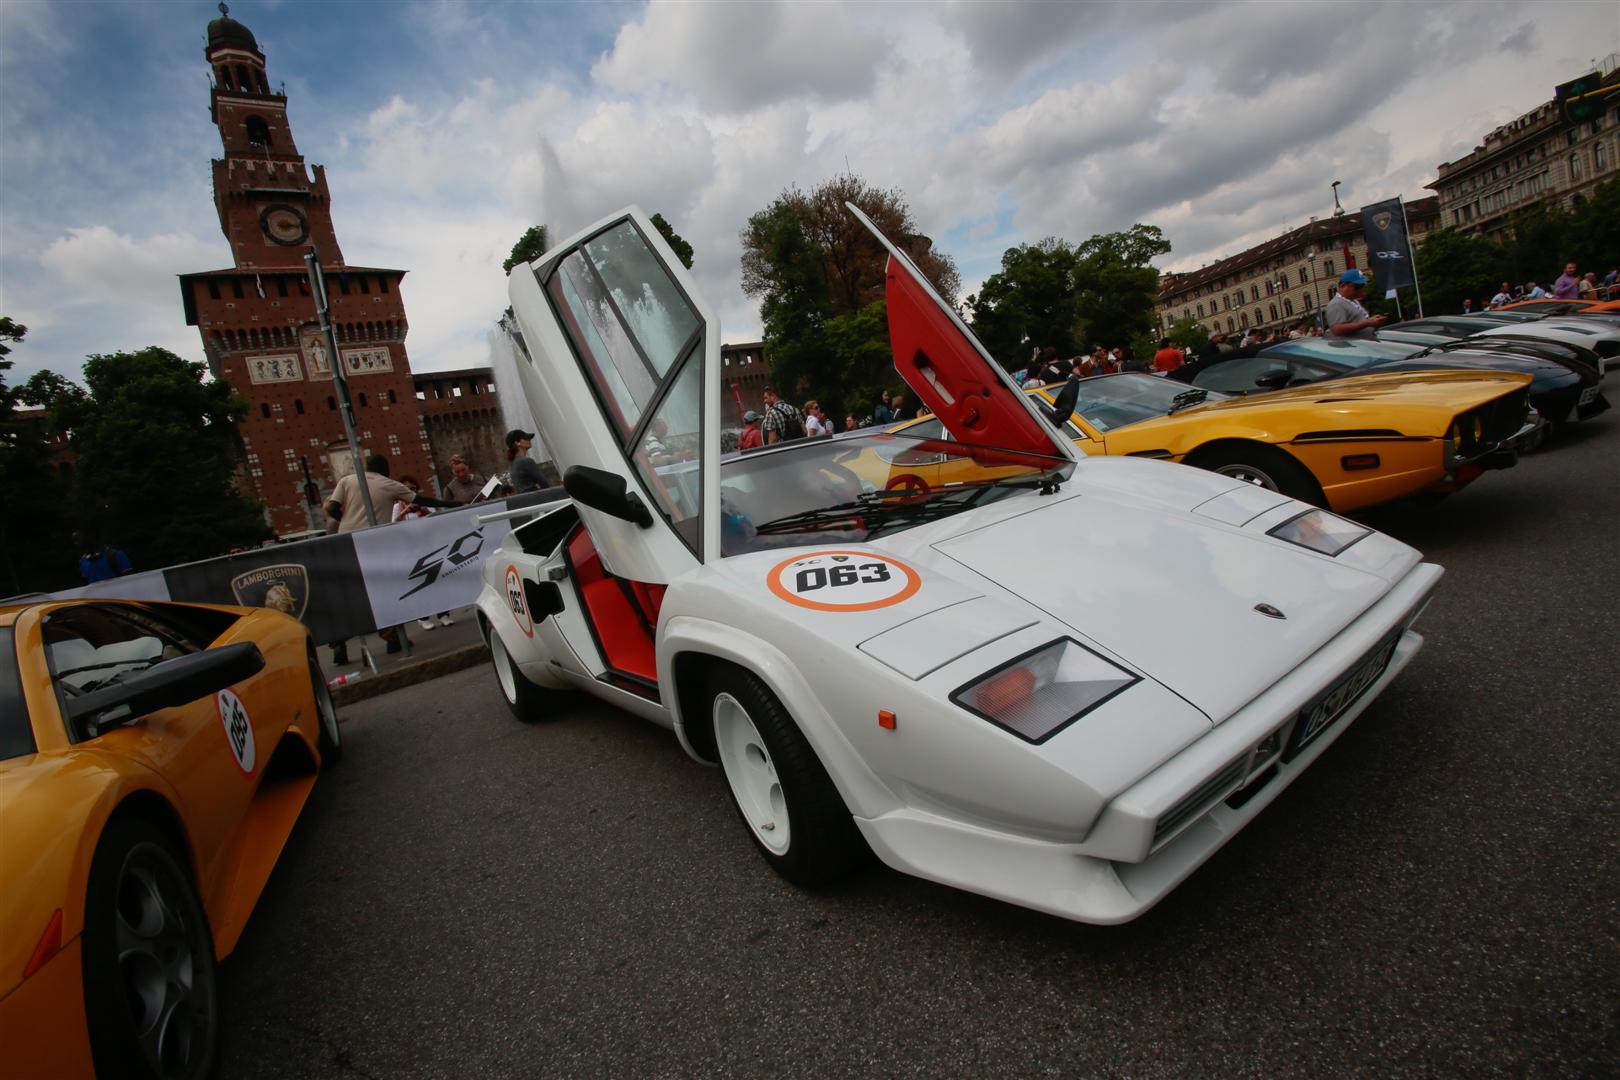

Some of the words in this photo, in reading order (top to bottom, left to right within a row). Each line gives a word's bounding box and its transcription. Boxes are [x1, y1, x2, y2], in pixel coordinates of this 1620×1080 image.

[237, 567, 302, 590] LAMBORGHINI
[796, 563, 891, 593] 063
[509, 590, 526, 615] 063
[230, 699, 248, 763] 095
